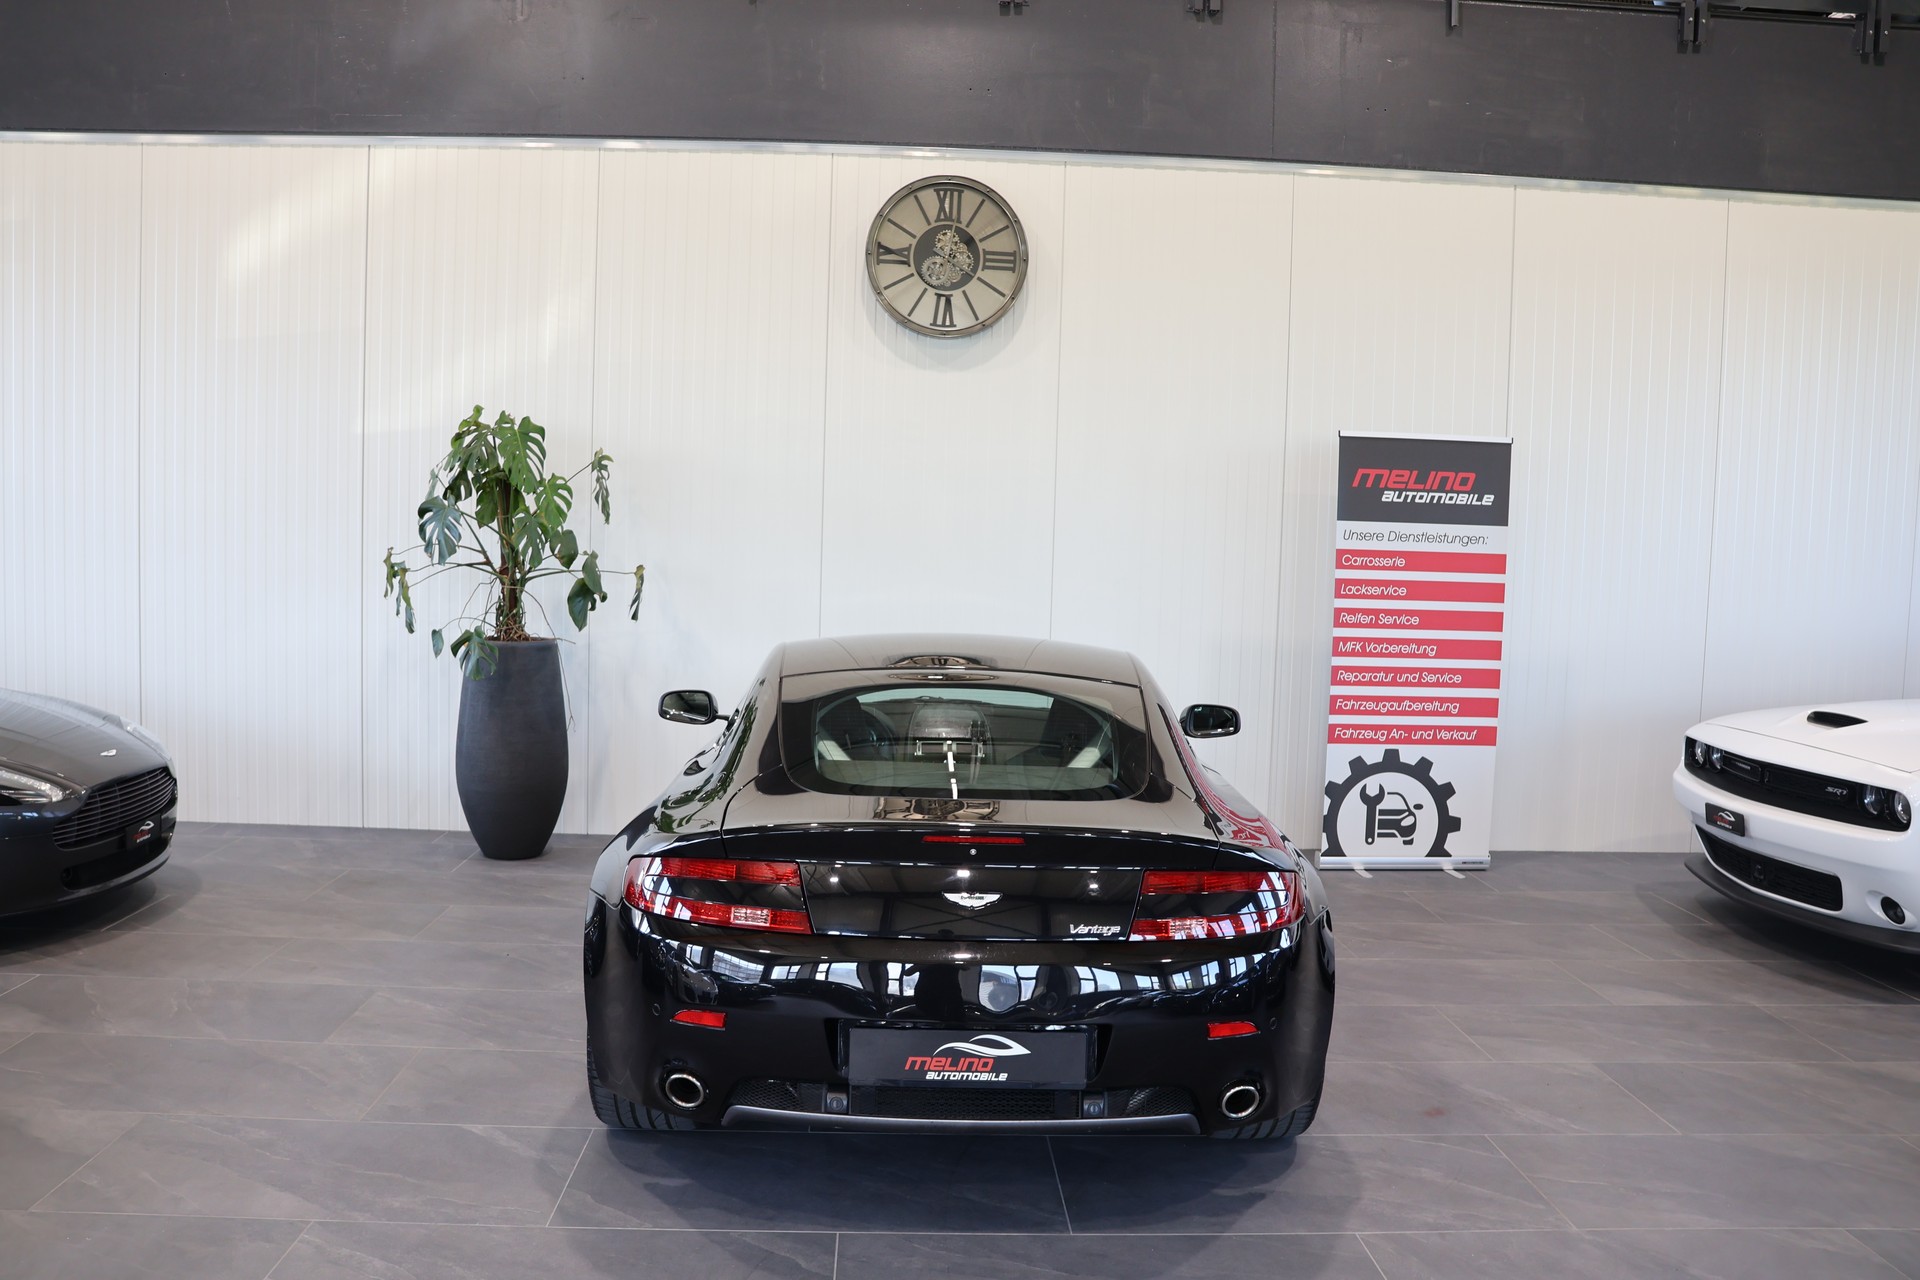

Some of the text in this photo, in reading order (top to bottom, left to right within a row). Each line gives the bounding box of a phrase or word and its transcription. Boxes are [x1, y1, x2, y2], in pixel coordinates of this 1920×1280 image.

[933, 188, 964, 224] XII
[982, 248, 1016, 273] III
[1352, 468, 1476, 491] MELINO
[1381, 490, 1495, 506] AUTOMOBILE
[1343, 529, 1488, 547] Unsere Dienstleistungen:
[1341, 554, 1406, 568] Carrosserie
[1340, 583, 1407, 597] Lackservice
[1339, 612, 1420, 626] Reifen Service
[1338, 641, 1437, 657] MFK Vorbereitung
[1336, 670, 1462, 684] Reparatur und Service
[1335, 698, 1460, 714] Fahrzeugaufbereitung
[1334, 727, 1478, 741] Fahrzeug An- und Verkauf
[1069, 923, 1121, 936] Vantage
[904, 1056, 994, 1072] MELINO
[925, 1071, 1009, 1082] AUTOMOBILE
